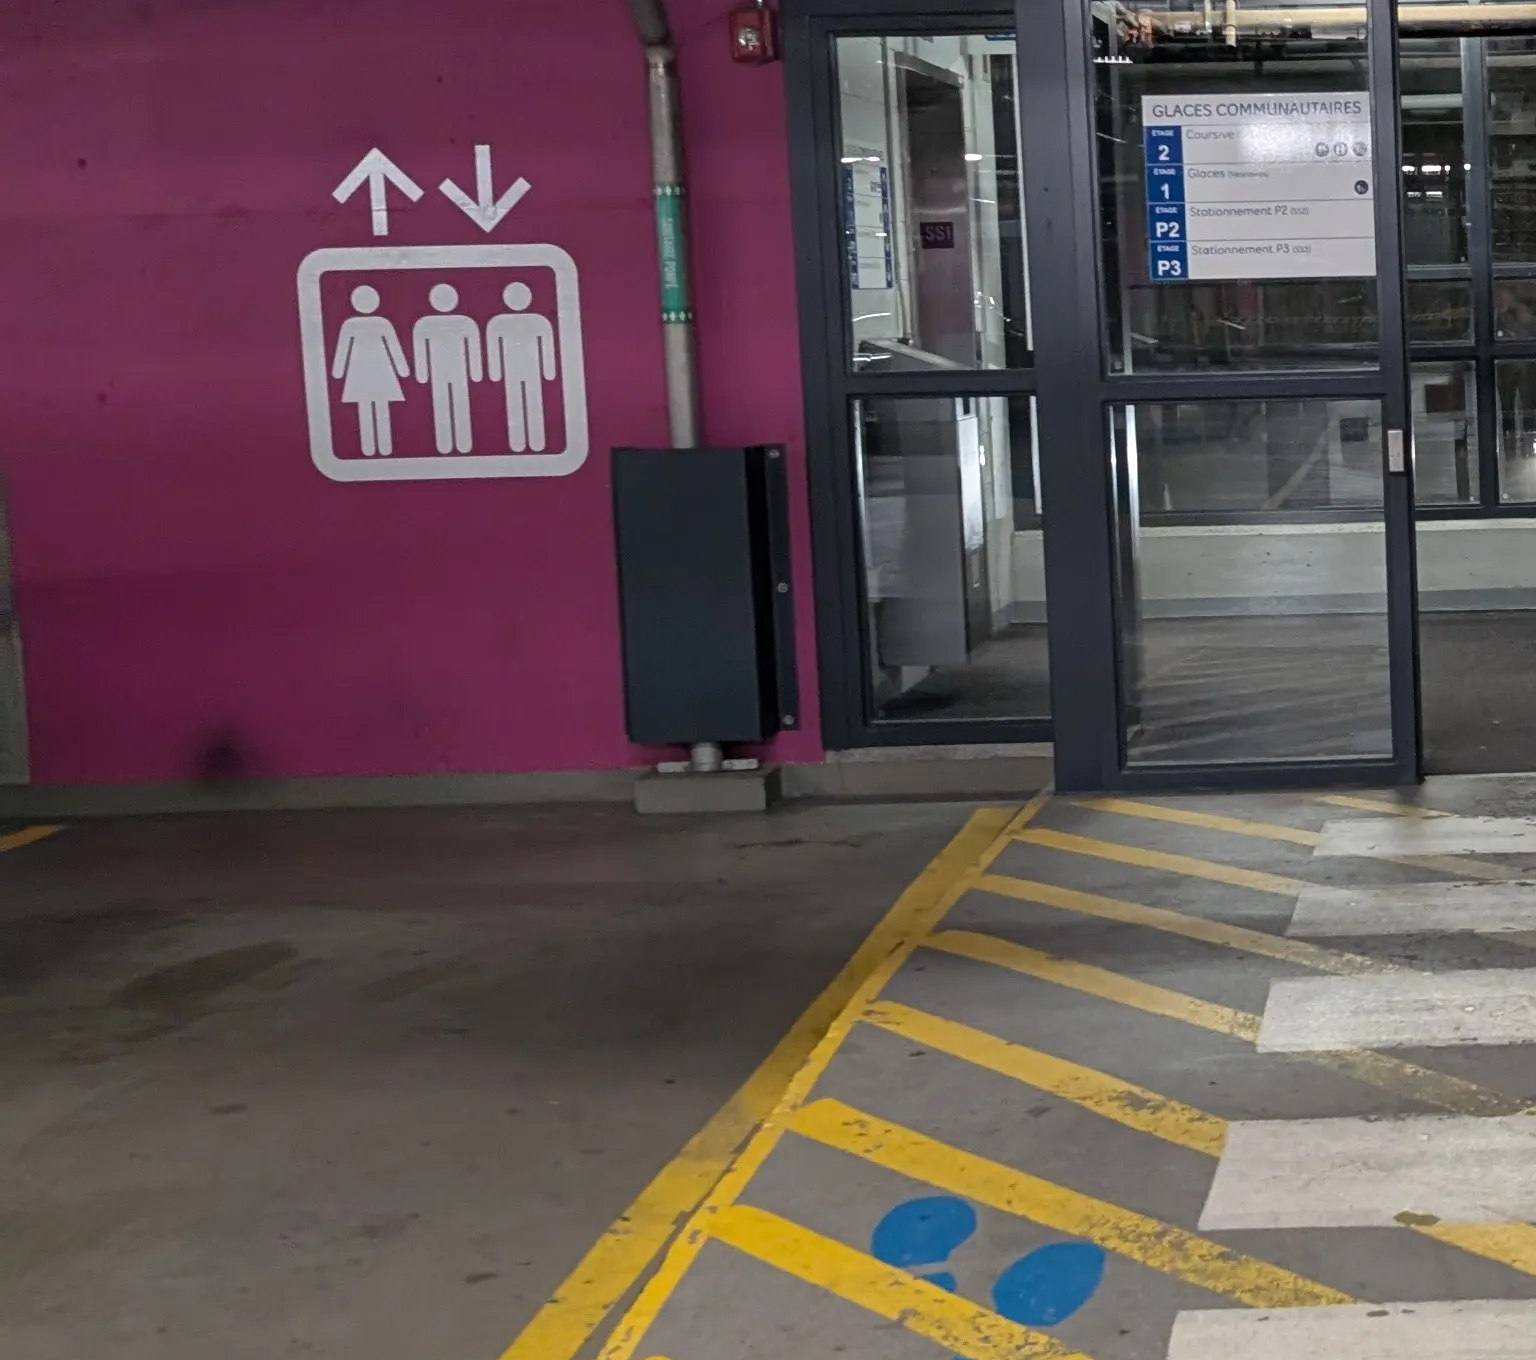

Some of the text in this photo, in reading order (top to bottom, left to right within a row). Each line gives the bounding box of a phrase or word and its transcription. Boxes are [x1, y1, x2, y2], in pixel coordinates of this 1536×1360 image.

[1152, 100, 1362, 118] GLACES COMMUNAUTAIRES
[1185, 129, 1236, 140] Coursive
[1157, 145, 1171, 161] 2
[1187, 168, 1226, 179] Glaces
[1160, 183, 1170, 200] 1
[1189, 205, 1273, 217] Stationnement
[1275, 205, 1288, 216] P2
[1155, 222, 1181, 238] P2
[1191, 244, 1274, 256] Stationnement
[1276, 243, 1290, 254] P3
[1157, 260, 1182, 277] P3
